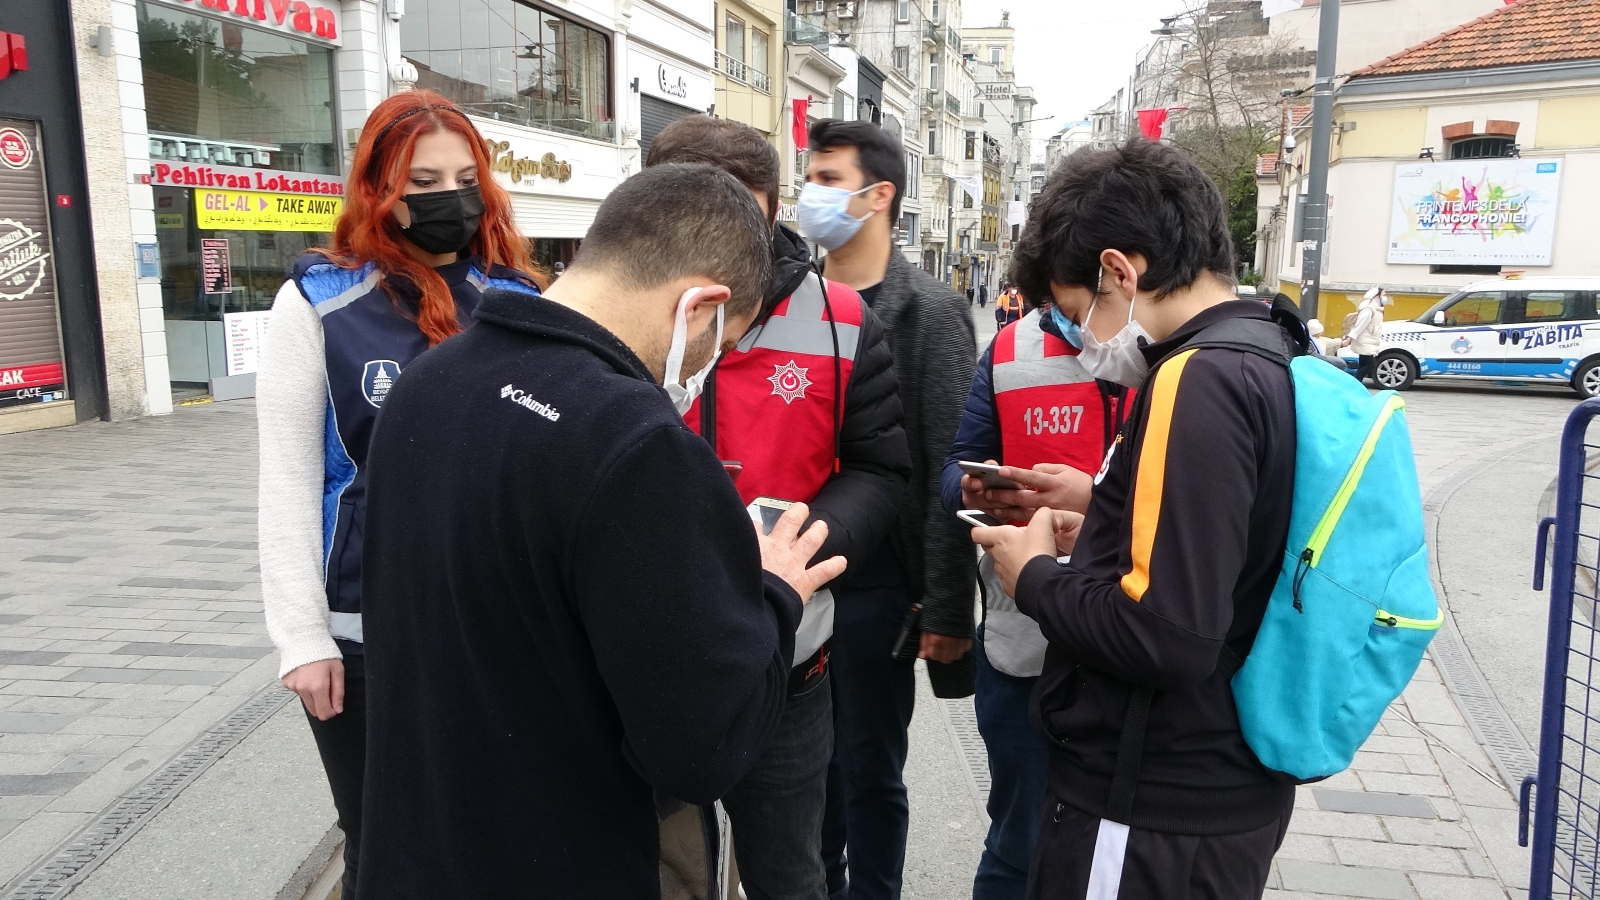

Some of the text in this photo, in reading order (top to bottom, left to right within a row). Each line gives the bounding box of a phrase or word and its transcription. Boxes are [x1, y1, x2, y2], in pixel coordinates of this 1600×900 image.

[985, 84, 1011, 94] Hotel
[155, 163, 344, 195] Pehlivan Lokantası
[205, 192, 338, 215] GEL-AL TAKE AWAY
[1417, 200, 1487, 213] PRINTEMPS
[1490, 199, 1508, 211] DE
[1416, 212, 1527, 224] FRANCOPHONIE!
[1523, 324, 1583, 350] ZABITA
[0, 369, 25, 386] AK
[510, 389, 561, 422] Columbia
[1023, 405, 1084, 436] 13-337
